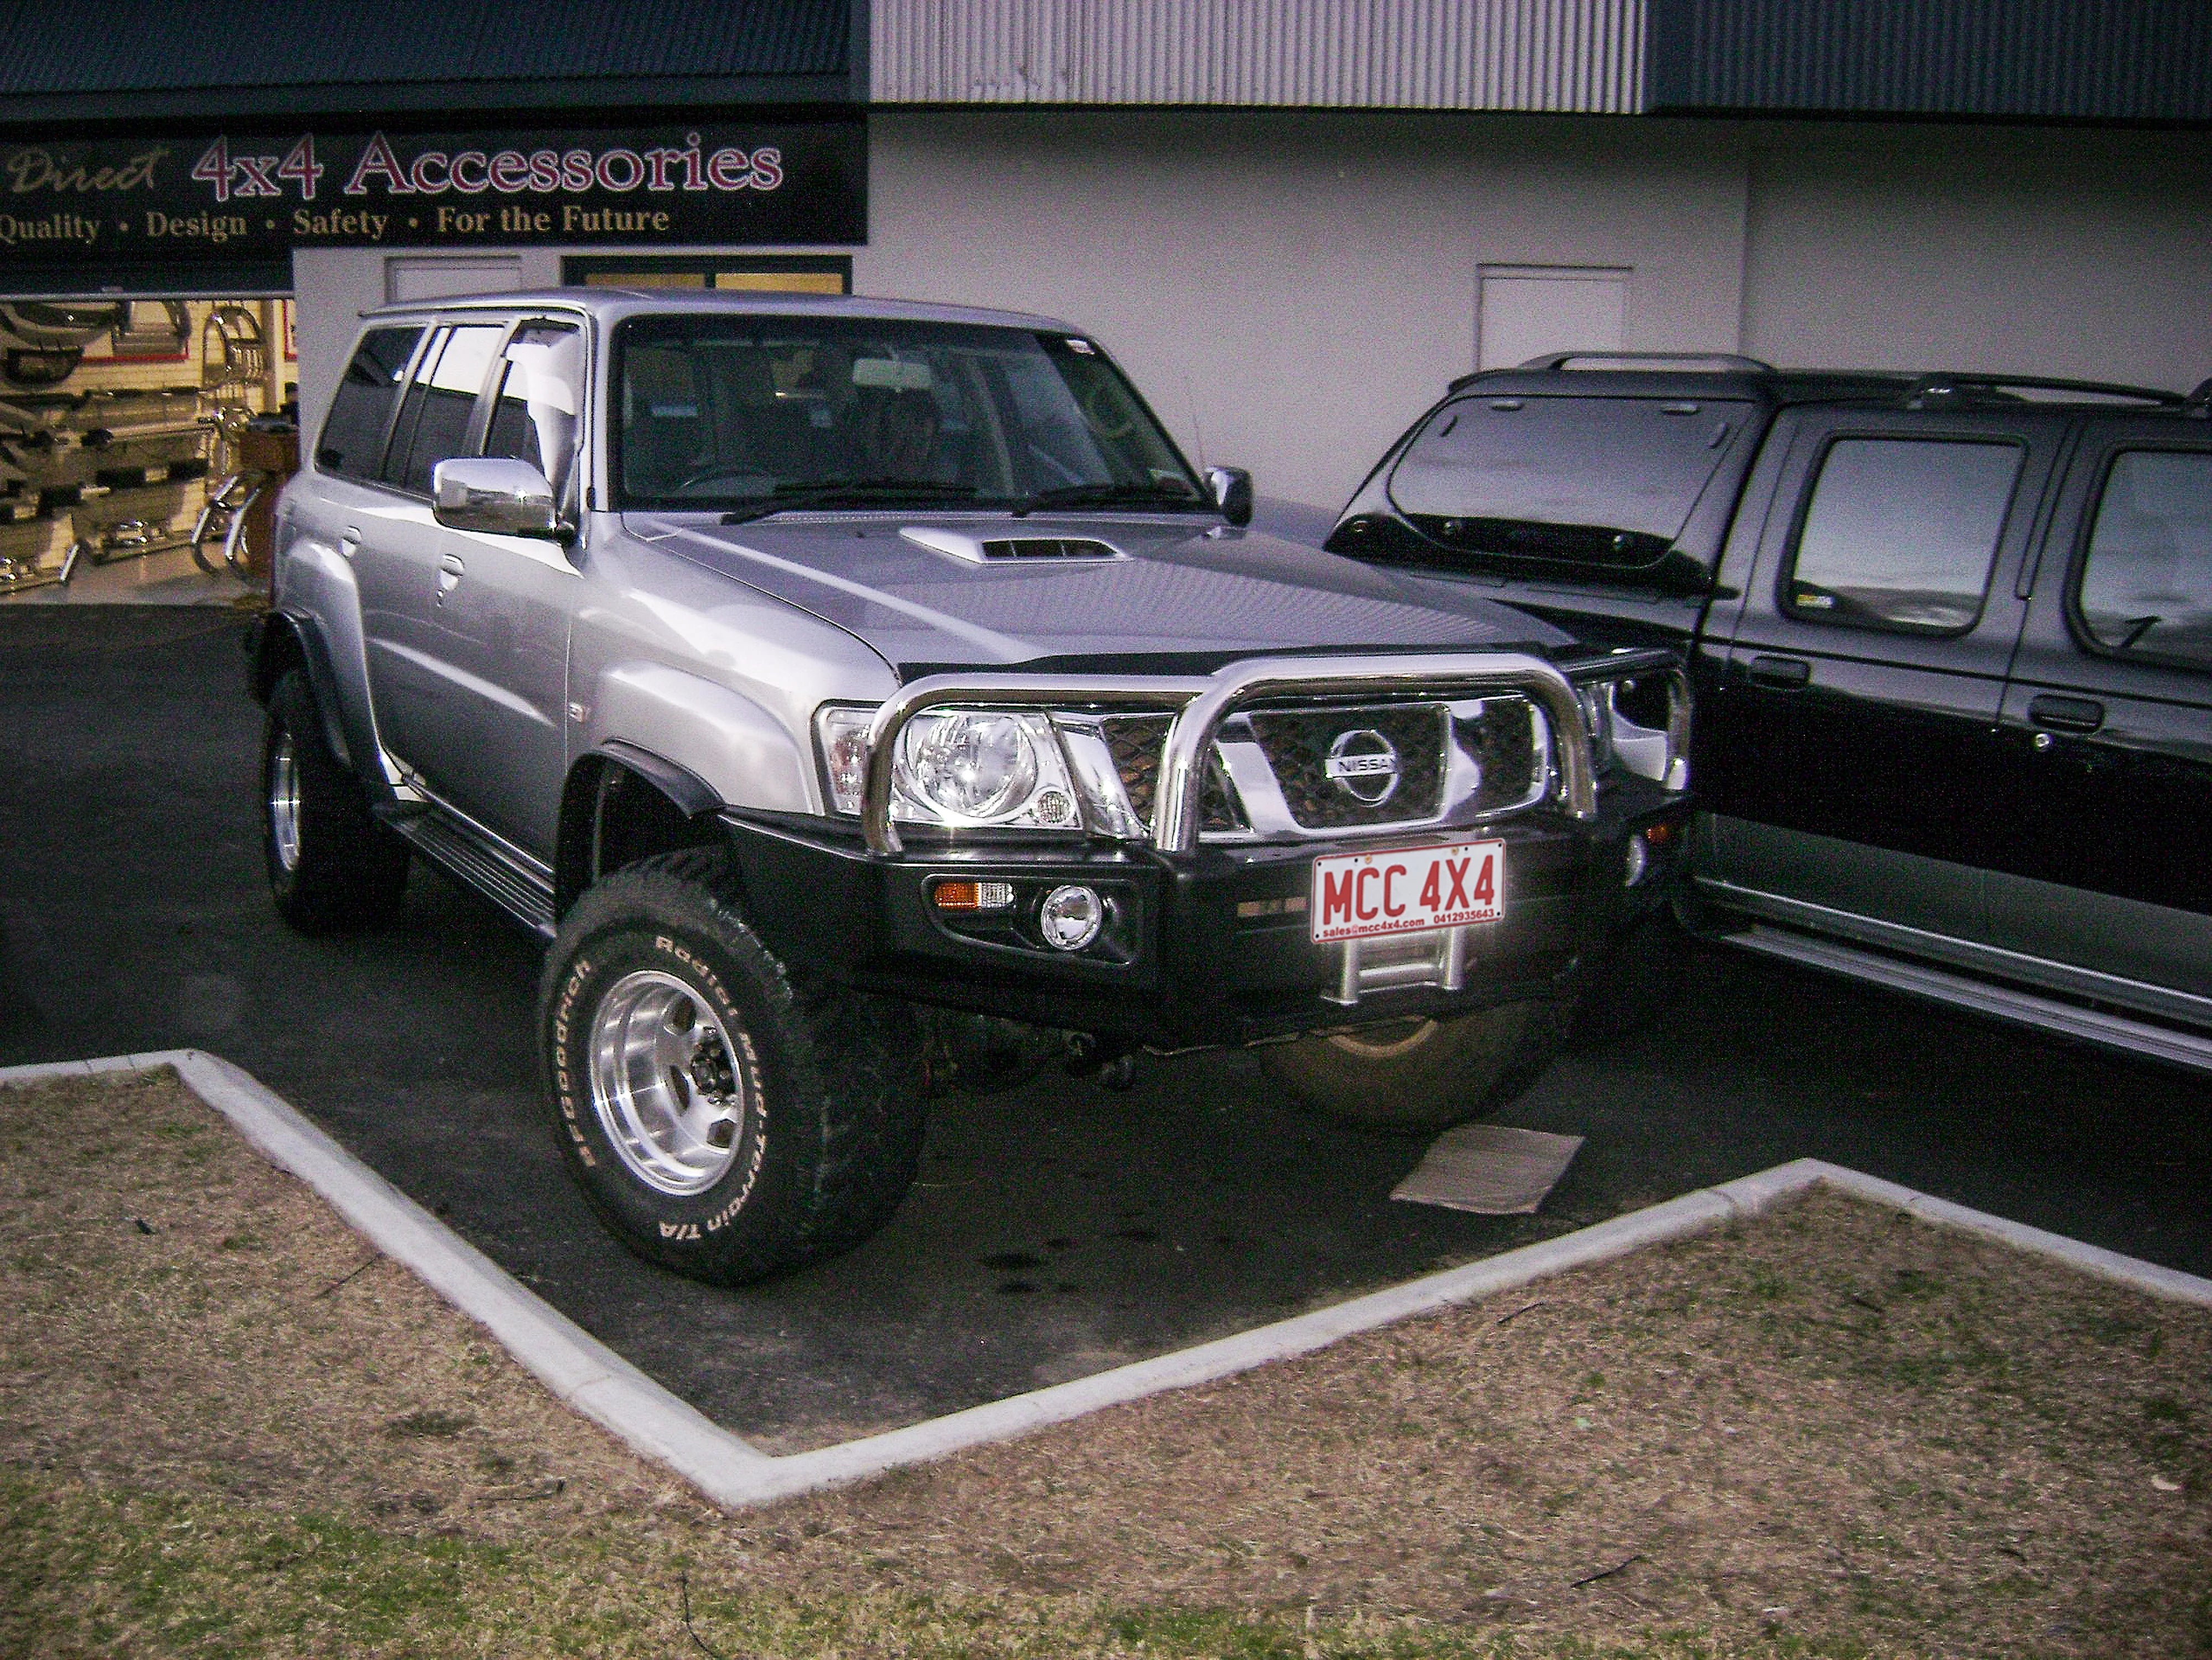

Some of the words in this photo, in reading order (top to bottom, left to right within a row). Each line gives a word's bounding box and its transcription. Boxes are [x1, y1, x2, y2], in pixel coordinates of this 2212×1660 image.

[7, 146, 169, 193] Direct
[191, 134, 324, 201] 4x4
[344, 131, 784, 195] Accessories
[0, 214, 100, 244] Quality
[146, 211, 248, 242] Design
[293, 209, 388, 240] Safety
[437, 207, 491, 232] For
[500, 207, 551, 231] the
[562, 205, 669, 232] Future
[1338, 757, 1394, 772] NISSAN
[1323, 864, 1406, 925] MCC
[1419, 854, 1494, 912] 4X4
[1323, 917, 1425, 937] sales@mcc4x4.com
[1433, 908, 1494, 925] 0412935643
[659, 1221, 702, 1240] T/A
